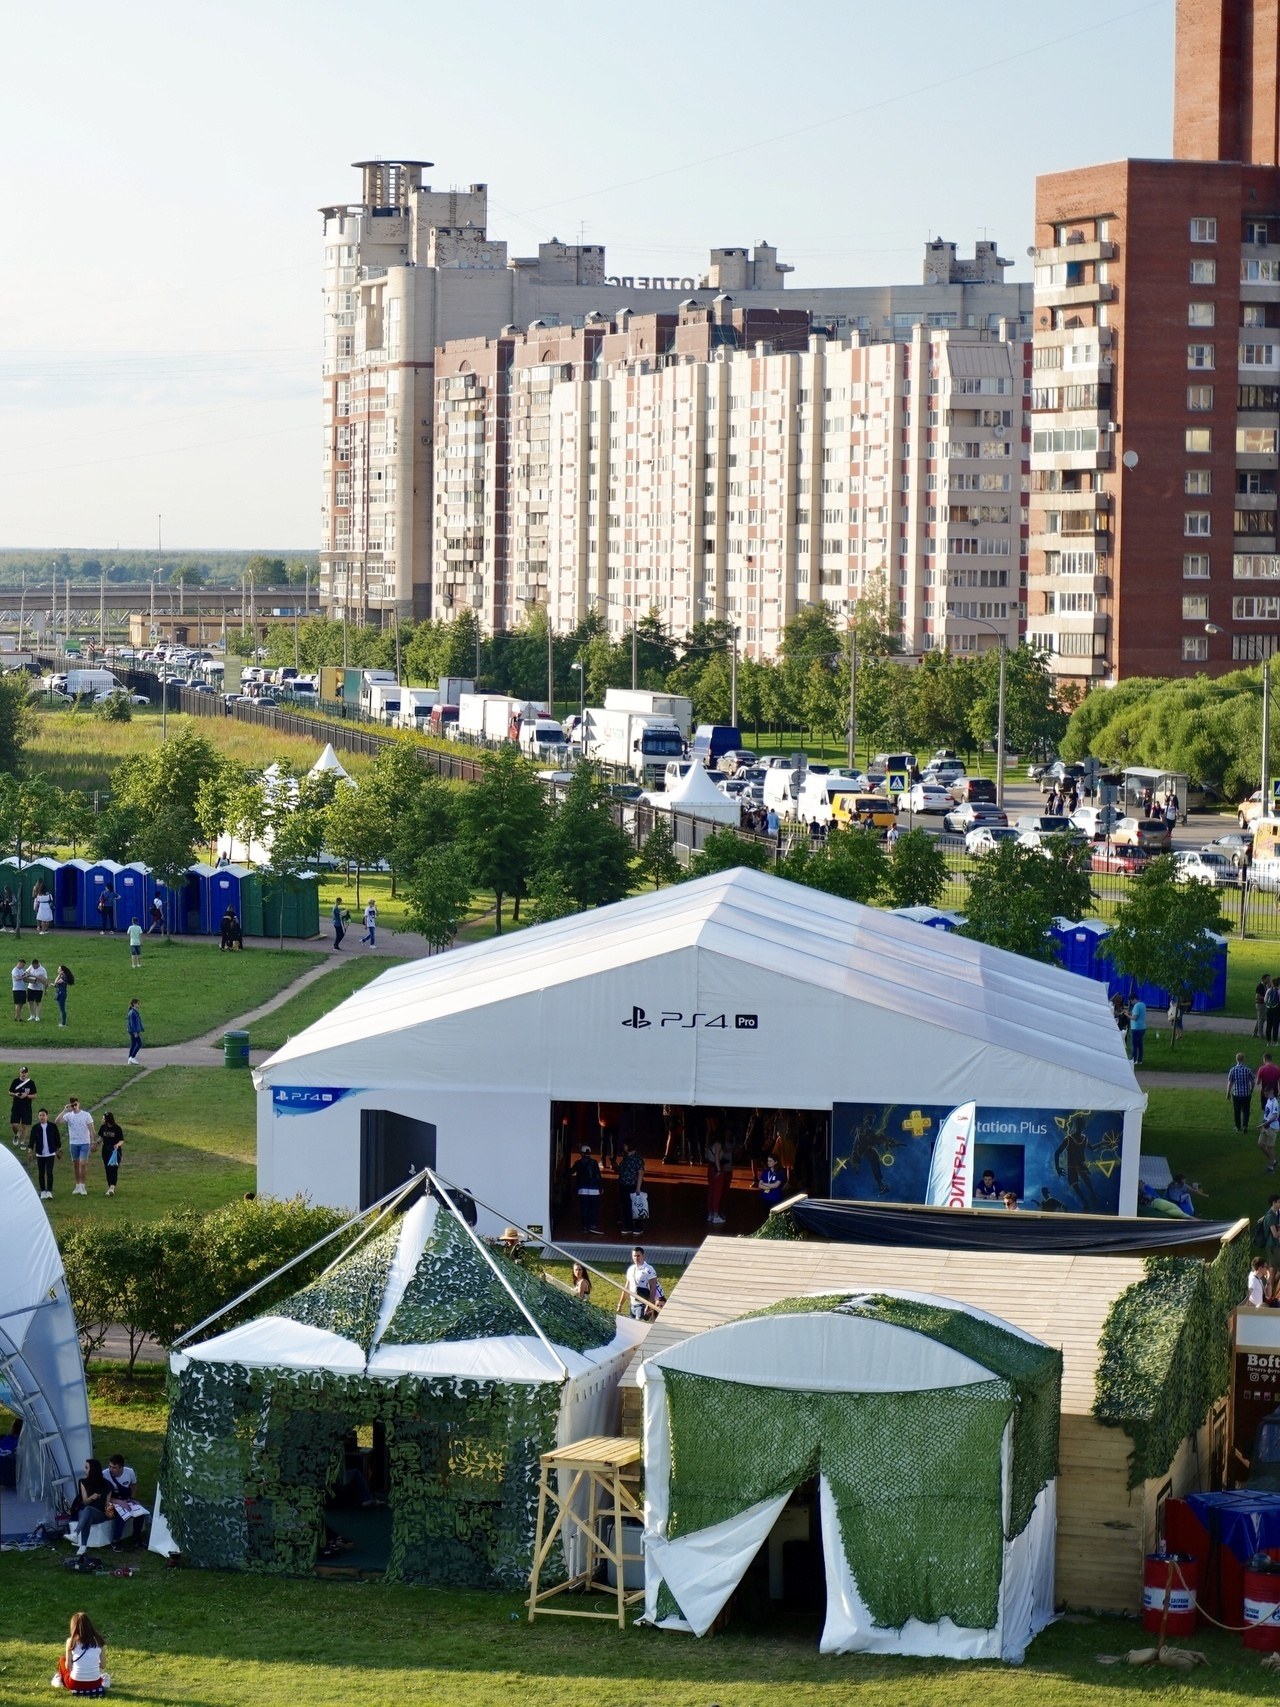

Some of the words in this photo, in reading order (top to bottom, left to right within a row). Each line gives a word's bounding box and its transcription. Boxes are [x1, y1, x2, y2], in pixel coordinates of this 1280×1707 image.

[661, 1012, 728, 1028] PS4
[738, 1017, 756, 1027] Pro
[291, 1092, 322, 1101] PS4
